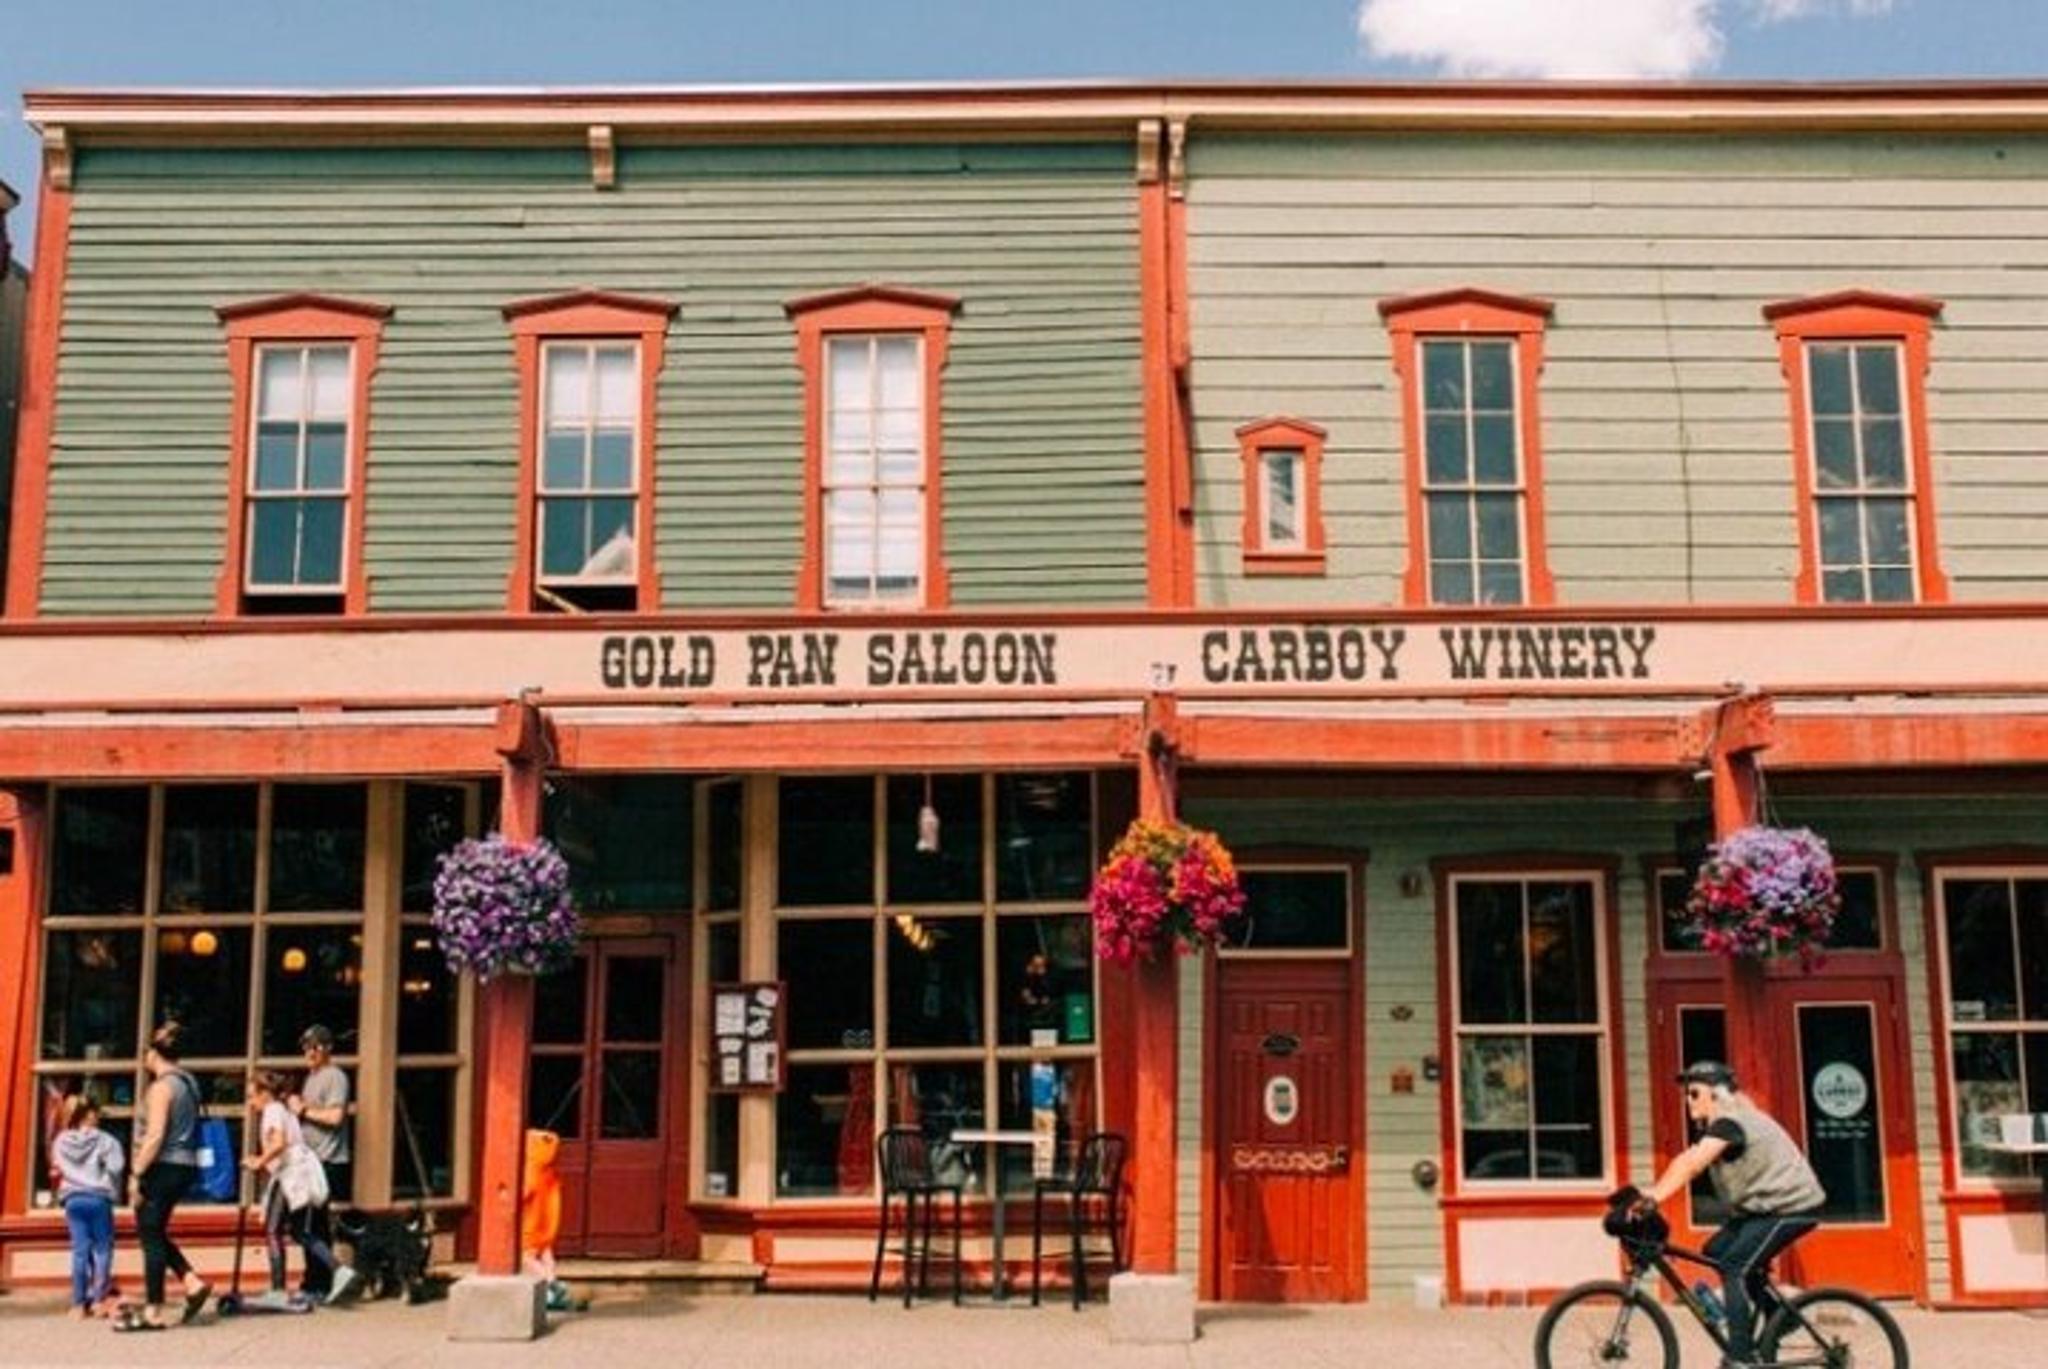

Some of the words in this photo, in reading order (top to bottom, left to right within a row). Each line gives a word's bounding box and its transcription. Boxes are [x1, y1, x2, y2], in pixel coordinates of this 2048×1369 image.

[601, 632, 716, 689] GOLD
[748, 633, 838, 688] PAN
[868, 632, 1057, 686] SALOON
[1202, 626, 1406, 683] CARBOY
[1440, 625, 1656, 681] WINERY
